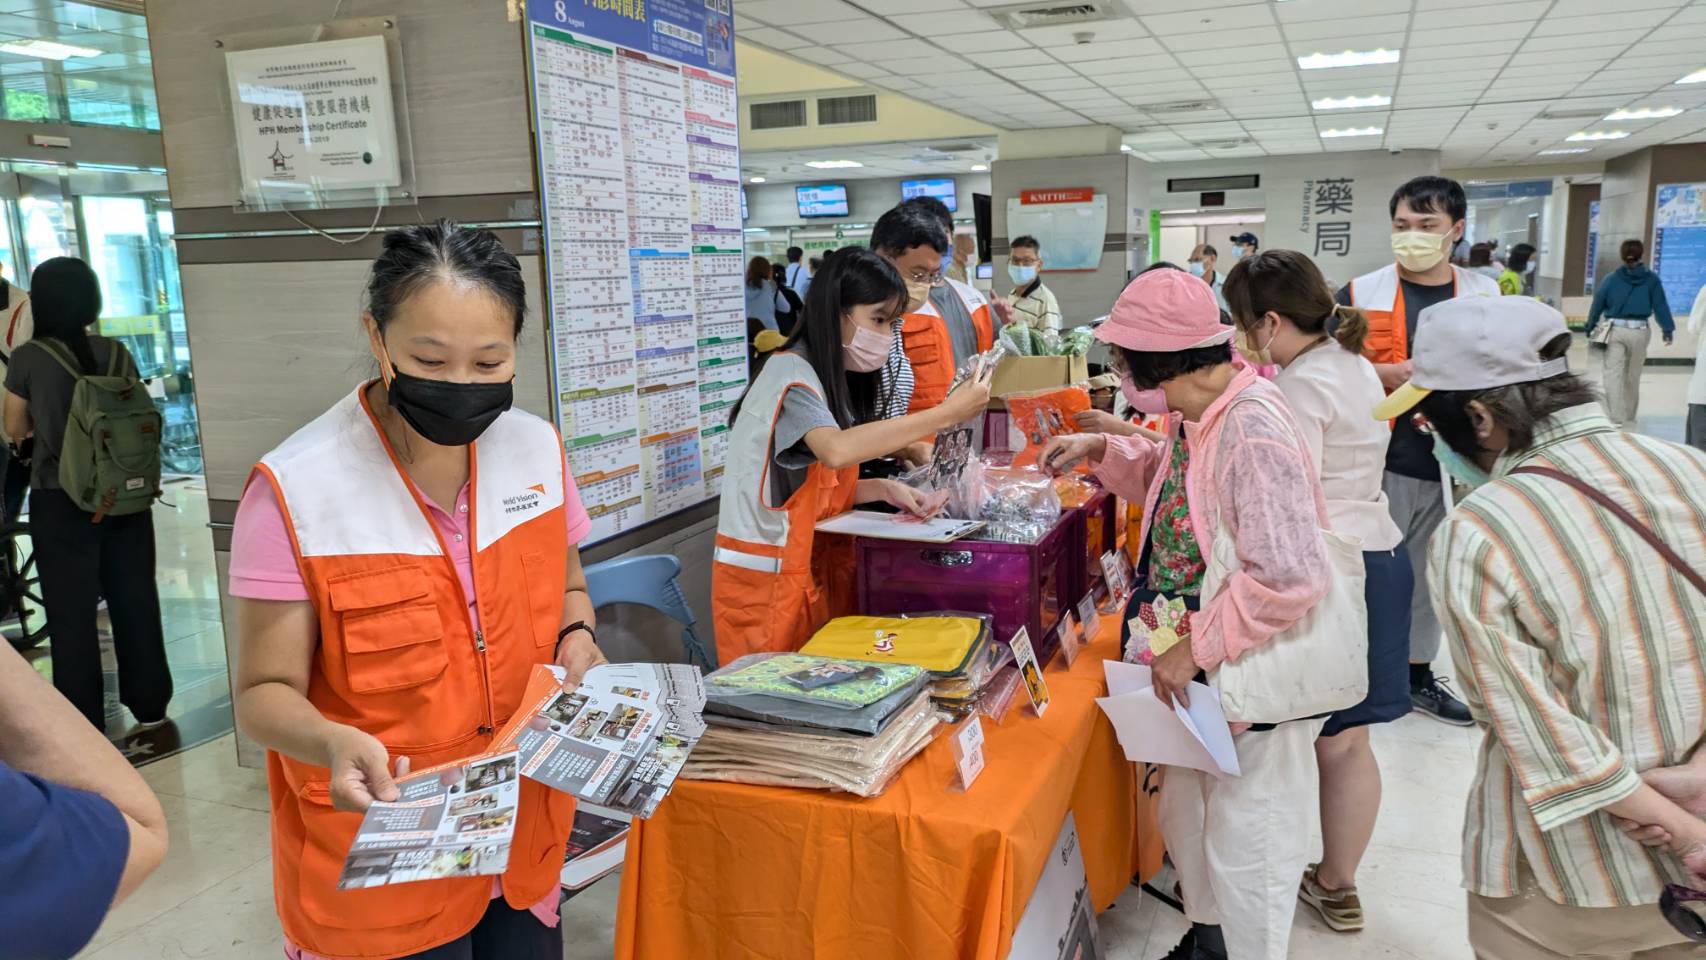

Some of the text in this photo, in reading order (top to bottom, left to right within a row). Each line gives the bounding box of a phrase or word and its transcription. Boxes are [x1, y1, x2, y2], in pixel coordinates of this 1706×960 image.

[555, 0, 567, 23] 8
[259, 119, 368, 136] HPH Membeship Certificate
[1300, 180, 1314, 233] Pharmacy
[1314, 178, 1354, 257] 藥局
[516, 493, 539, 503] Vision
